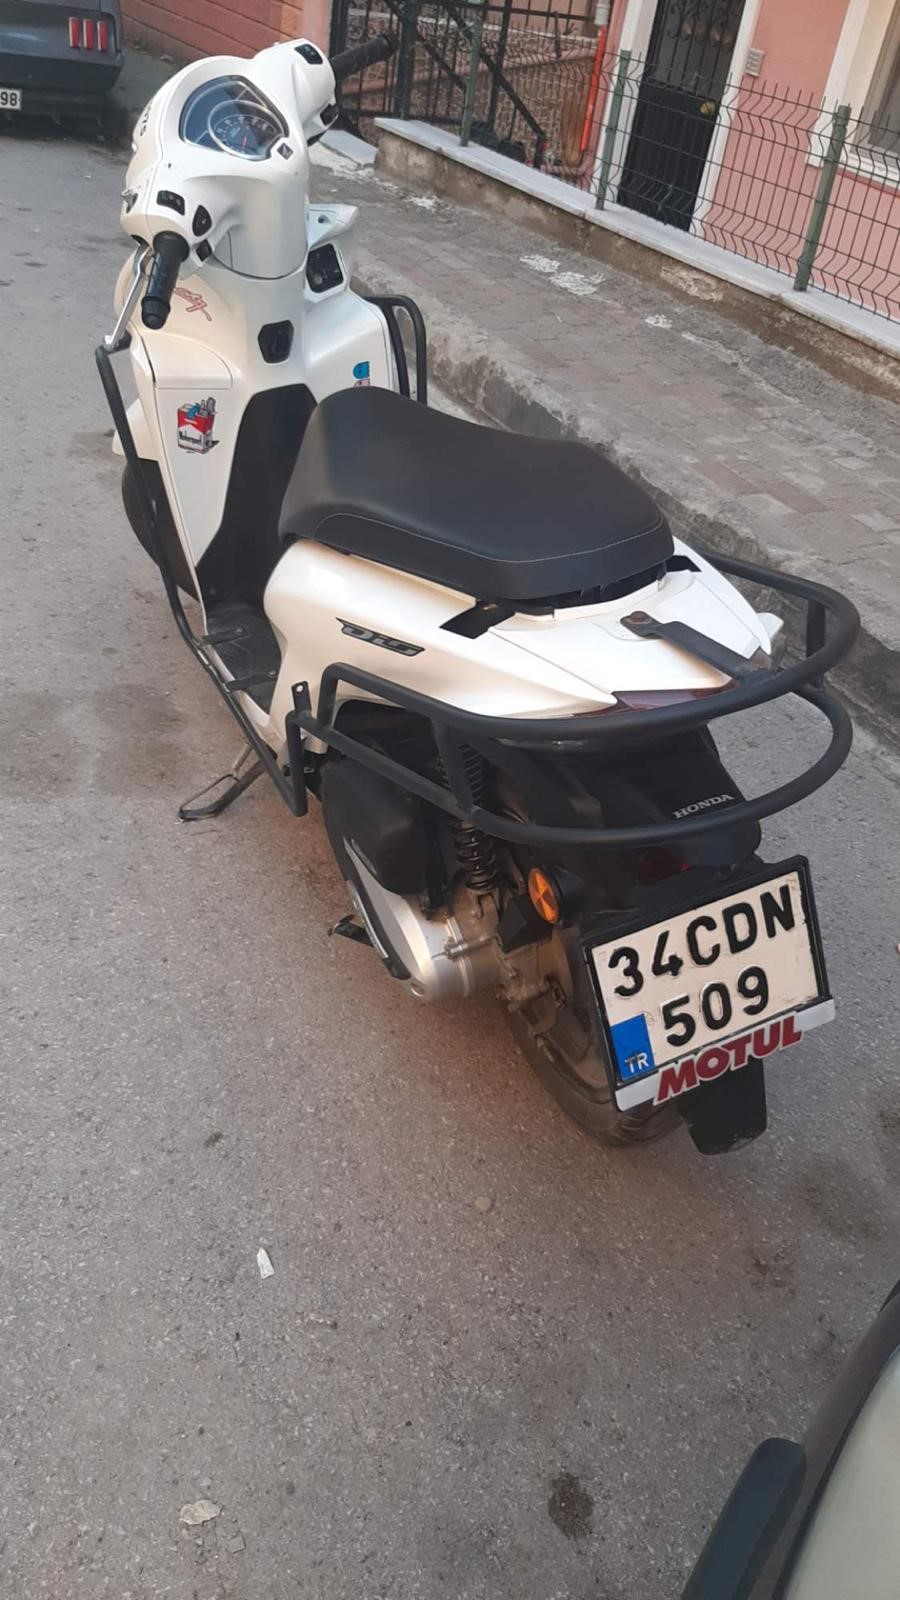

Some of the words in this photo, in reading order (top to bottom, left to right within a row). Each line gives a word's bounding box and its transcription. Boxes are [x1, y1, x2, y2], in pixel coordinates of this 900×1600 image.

[672, 794, 735, 819] HONDA
[607, 884, 796, 997] 34CDN
[661, 966, 769, 1047] 509
[624, 1052, 649, 1073] TR
[656, 1016, 802, 1102] MOTUL
